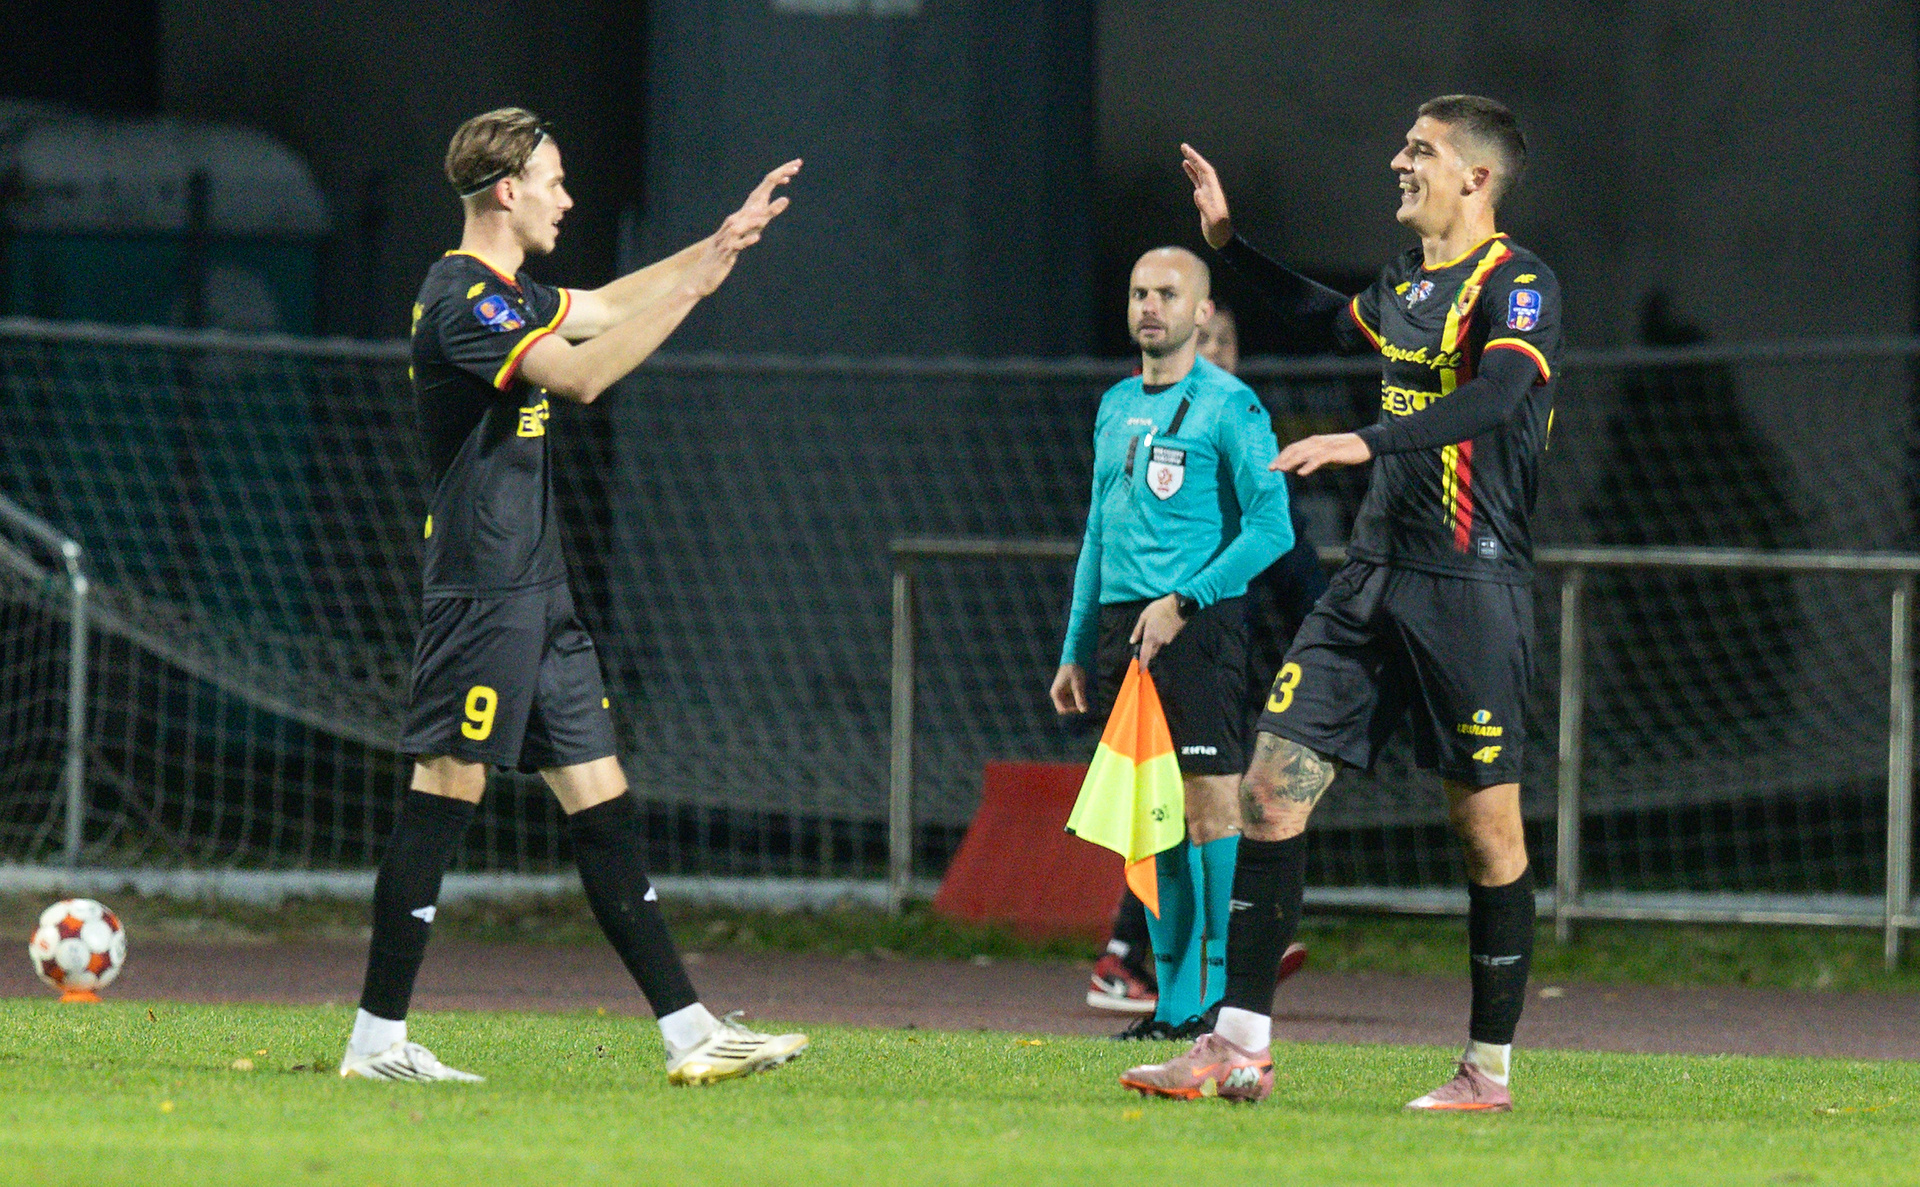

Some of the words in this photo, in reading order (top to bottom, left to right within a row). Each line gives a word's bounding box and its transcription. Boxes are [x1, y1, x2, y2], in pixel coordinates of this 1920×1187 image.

[460, 684, 499, 742] 9
[1267, 661, 1303, 714] 3
[1472, 745, 1502, 764] 4F
